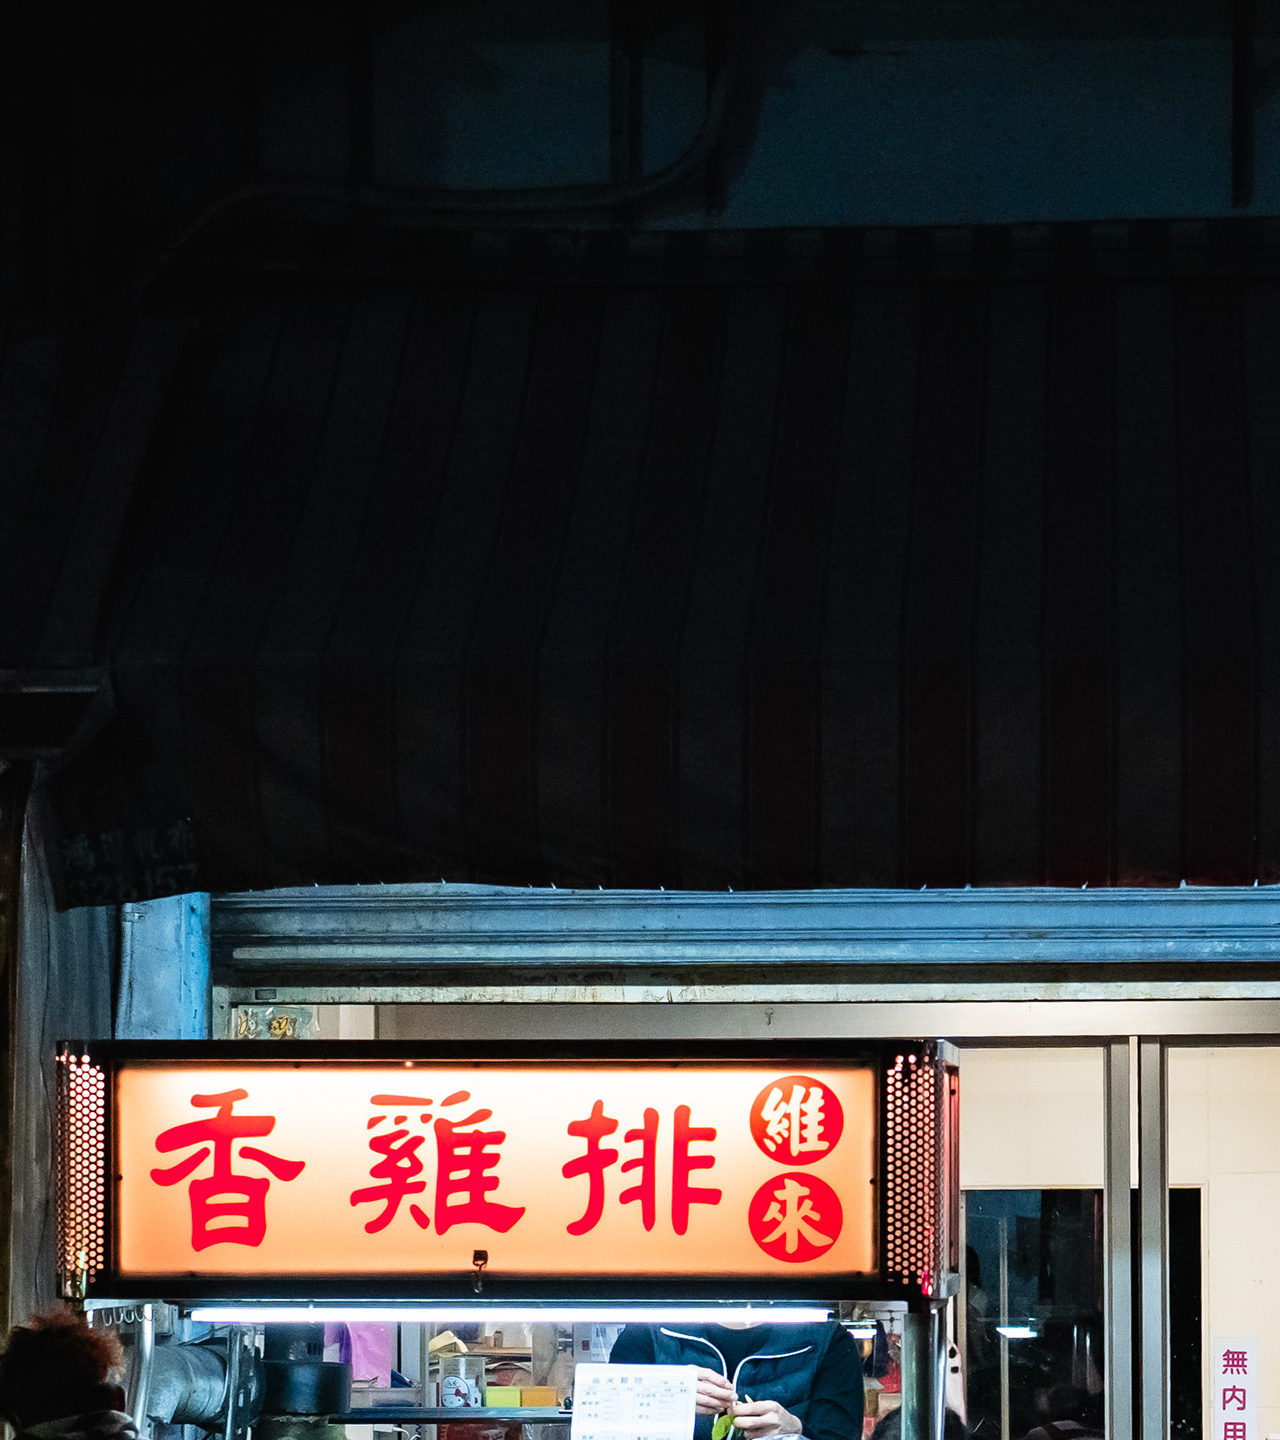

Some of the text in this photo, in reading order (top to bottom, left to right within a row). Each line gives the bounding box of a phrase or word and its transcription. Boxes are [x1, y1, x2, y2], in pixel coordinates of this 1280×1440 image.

[150, 1088, 721, 1252] 香雞排
[760, 1084, 834, 1254] 維來
